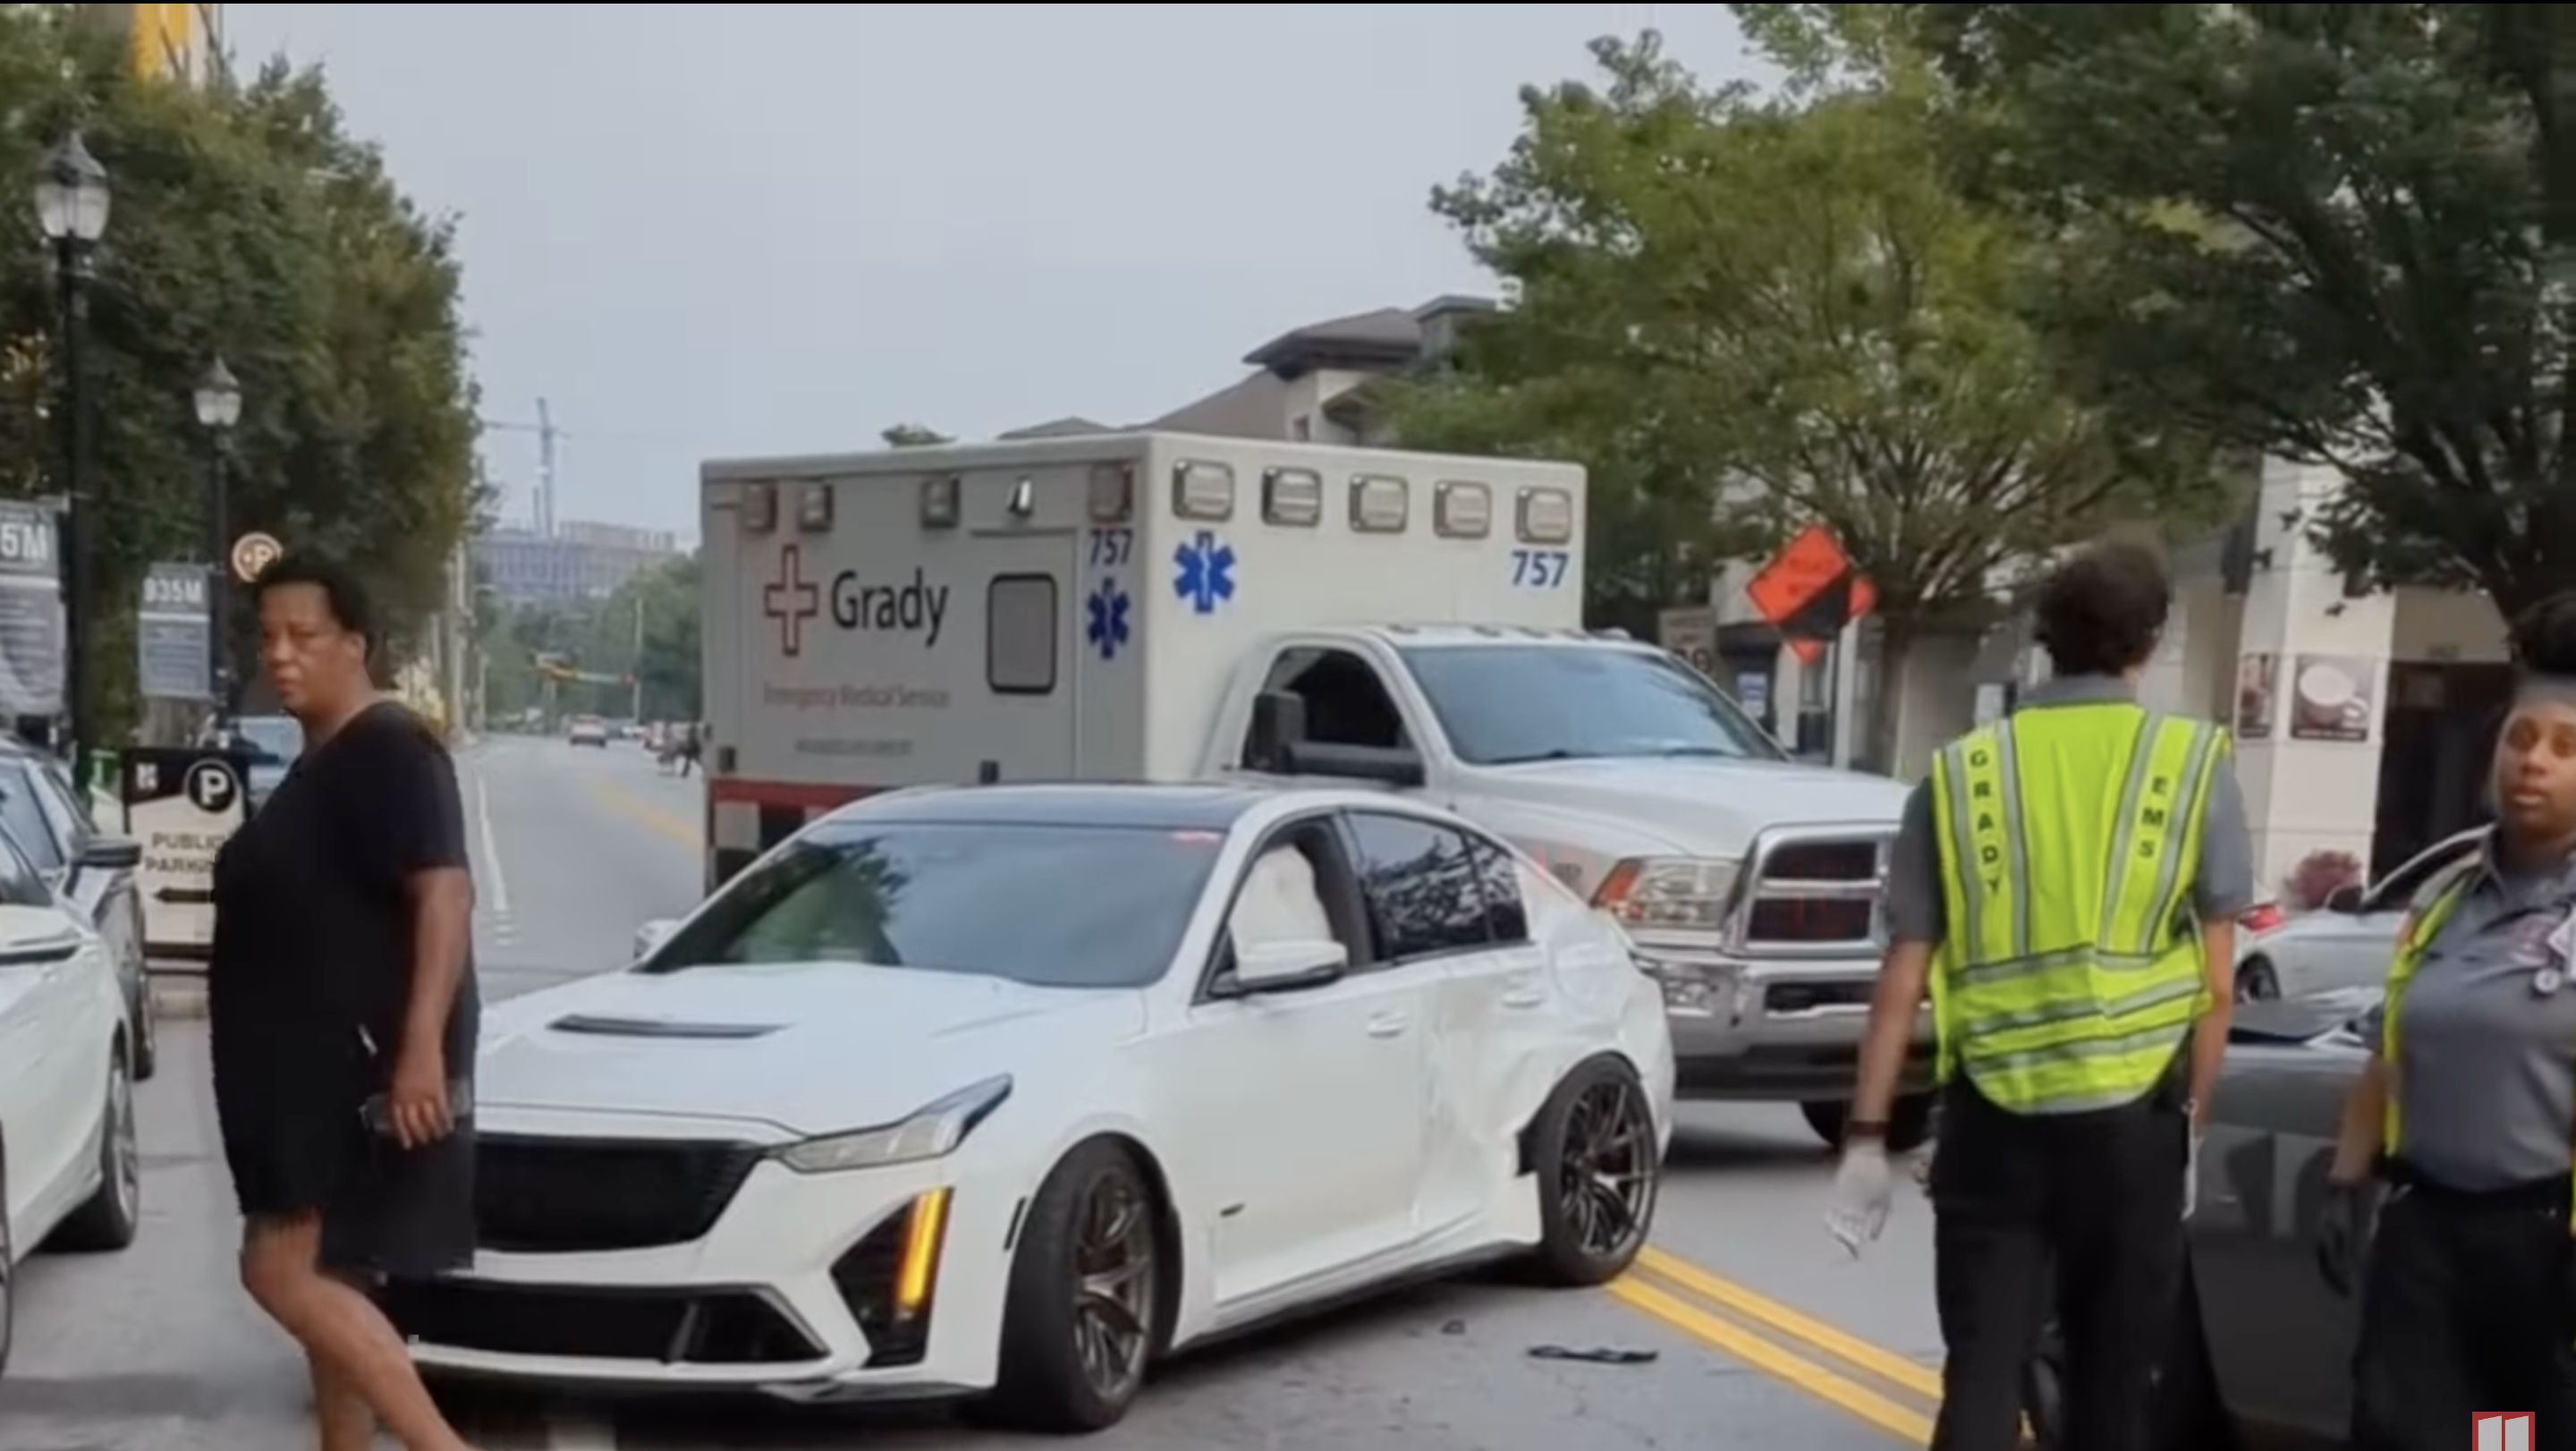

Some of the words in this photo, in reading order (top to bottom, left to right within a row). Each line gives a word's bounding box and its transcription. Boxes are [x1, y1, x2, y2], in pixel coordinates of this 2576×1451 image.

[1089, 528, 1133, 565] 757
[1511, 549, 1569, 587] 757
[832, 565, 949, 649] Grady
[199, 768, 229, 805] P
[1970, 750, 2000, 895] GRADY
[2138, 776, 2169, 859] EMS
